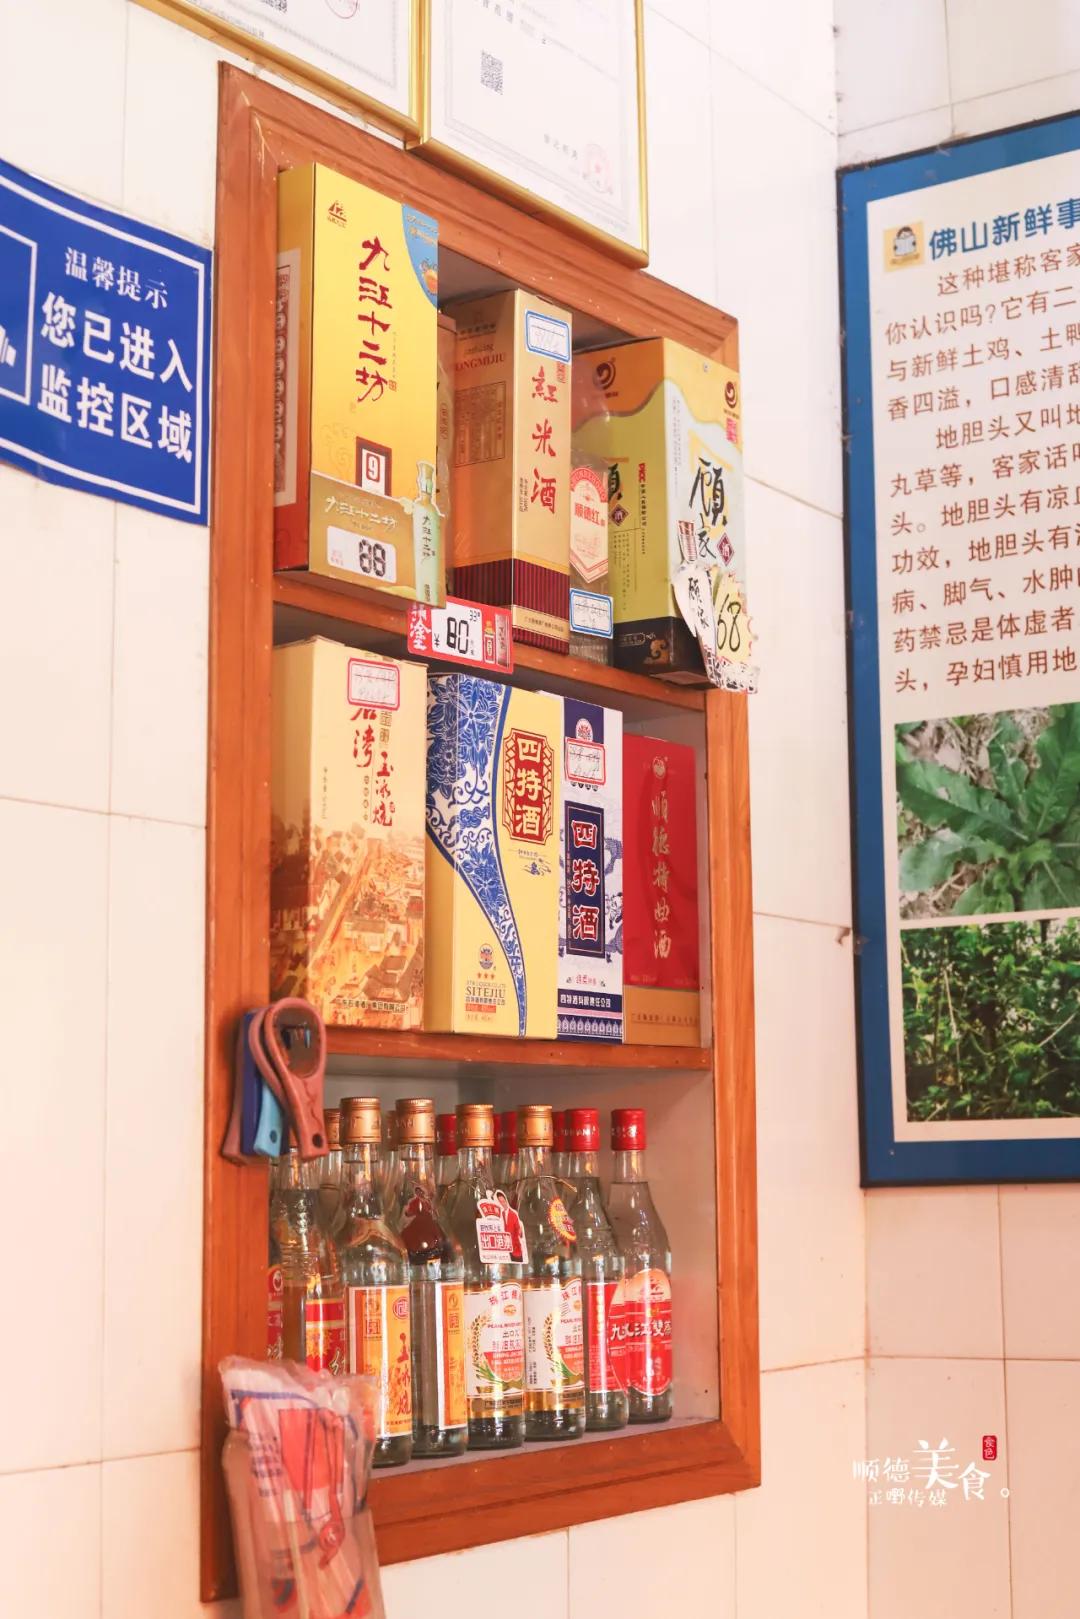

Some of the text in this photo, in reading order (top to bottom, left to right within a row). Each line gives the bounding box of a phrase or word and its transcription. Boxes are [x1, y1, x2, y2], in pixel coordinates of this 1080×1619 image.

[929, 198, 1080, 261] 佛山新鲜事
[64, 247, 168, 309] 温馨提示
[41, 292, 193, 393] 您已进入
[37, 364, 193, 463] 监控区域
[891, 484, 1080, 536] 头。地胆头有凉
[892, 524, 1080, 575] 功效，地胆头有
[892, 563, 1080, 614] 病、脚气、水肿
[716, 593, 741, 653] 68
[515, 737, 543, 836] 四特酒
[570, 819, 601, 942] 四特酒
[465, 986, 506, 999] SITEJIU
